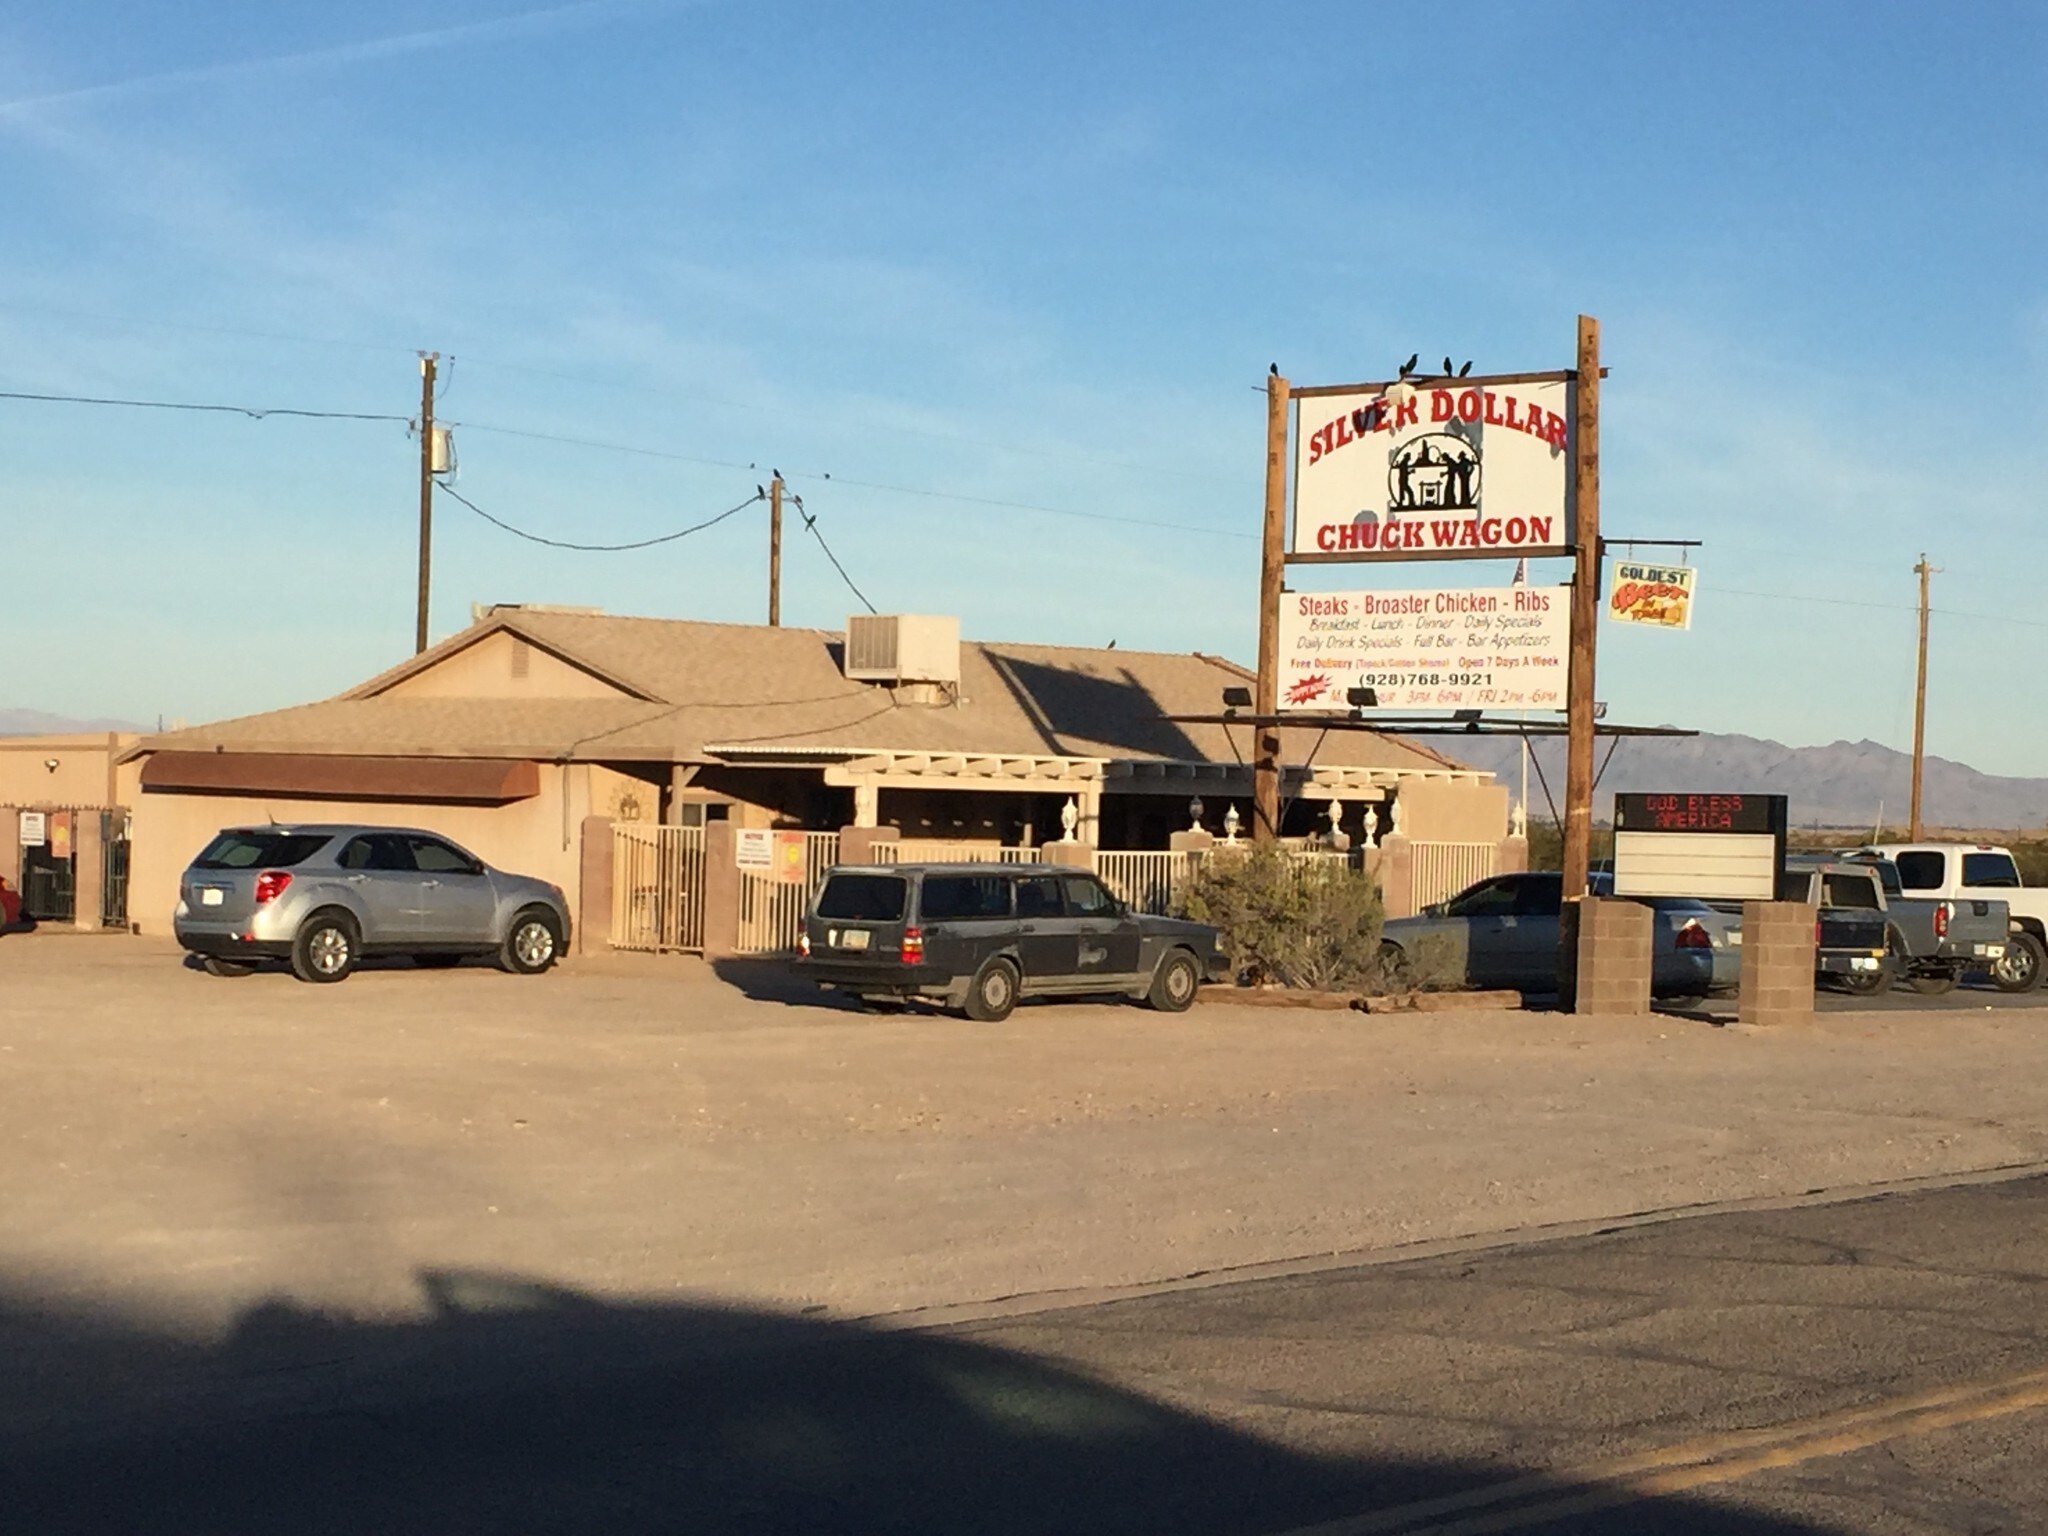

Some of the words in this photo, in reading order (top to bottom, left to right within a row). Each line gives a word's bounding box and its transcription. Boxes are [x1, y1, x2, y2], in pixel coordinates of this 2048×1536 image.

[1309, 395, 1419, 466] SILVER
[1431, 388, 1568, 452] DOLLAR
[1317, 520, 1425, 551] CHUCK
[1431, 515, 1553, 548] WAGON
[1299, 596, 1348, 616] Steaks
[1365, 594, 1430, 615] Broaster
[1435, 592, 1497, 613] Chicken
[1515, 591, 1550, 611] Ribs
[1309, 618, 1361, 632] Breakfast
[1371, 617, 1404, 630] Lunch
[1415, 615, 1454, 630] Dinner
[1464, 615, 1492, 631] Daily
[1495, 614, 1543, 631] Specials
[1297, 636, 1325, 651] Daily
[1326, 635, 1355, 649] Drink
[1357, 635, 1403, 651] Specials
[1414, 635, 1435, 648] Full
[1436, 634, 1457, 648] Bar
[1467, 633, 1489, 648] Bar
[1490, 633, 1551, 649] Appetizers
[1290, 658, 1312, 668] Free
[1458, 656, 1484, 670] Open
[1487, 656, 1493, 667] 7
[1495, 656, 1520, 670] Days
[1522, 656, 1530, 667] A
[1532, 655, 1559, 667] Week
[1359, 673, 1493, 687] (928)768-9921
[1646, 796, 1678, 811] GOD
[1687, 796, 1743, 811] BLESS
